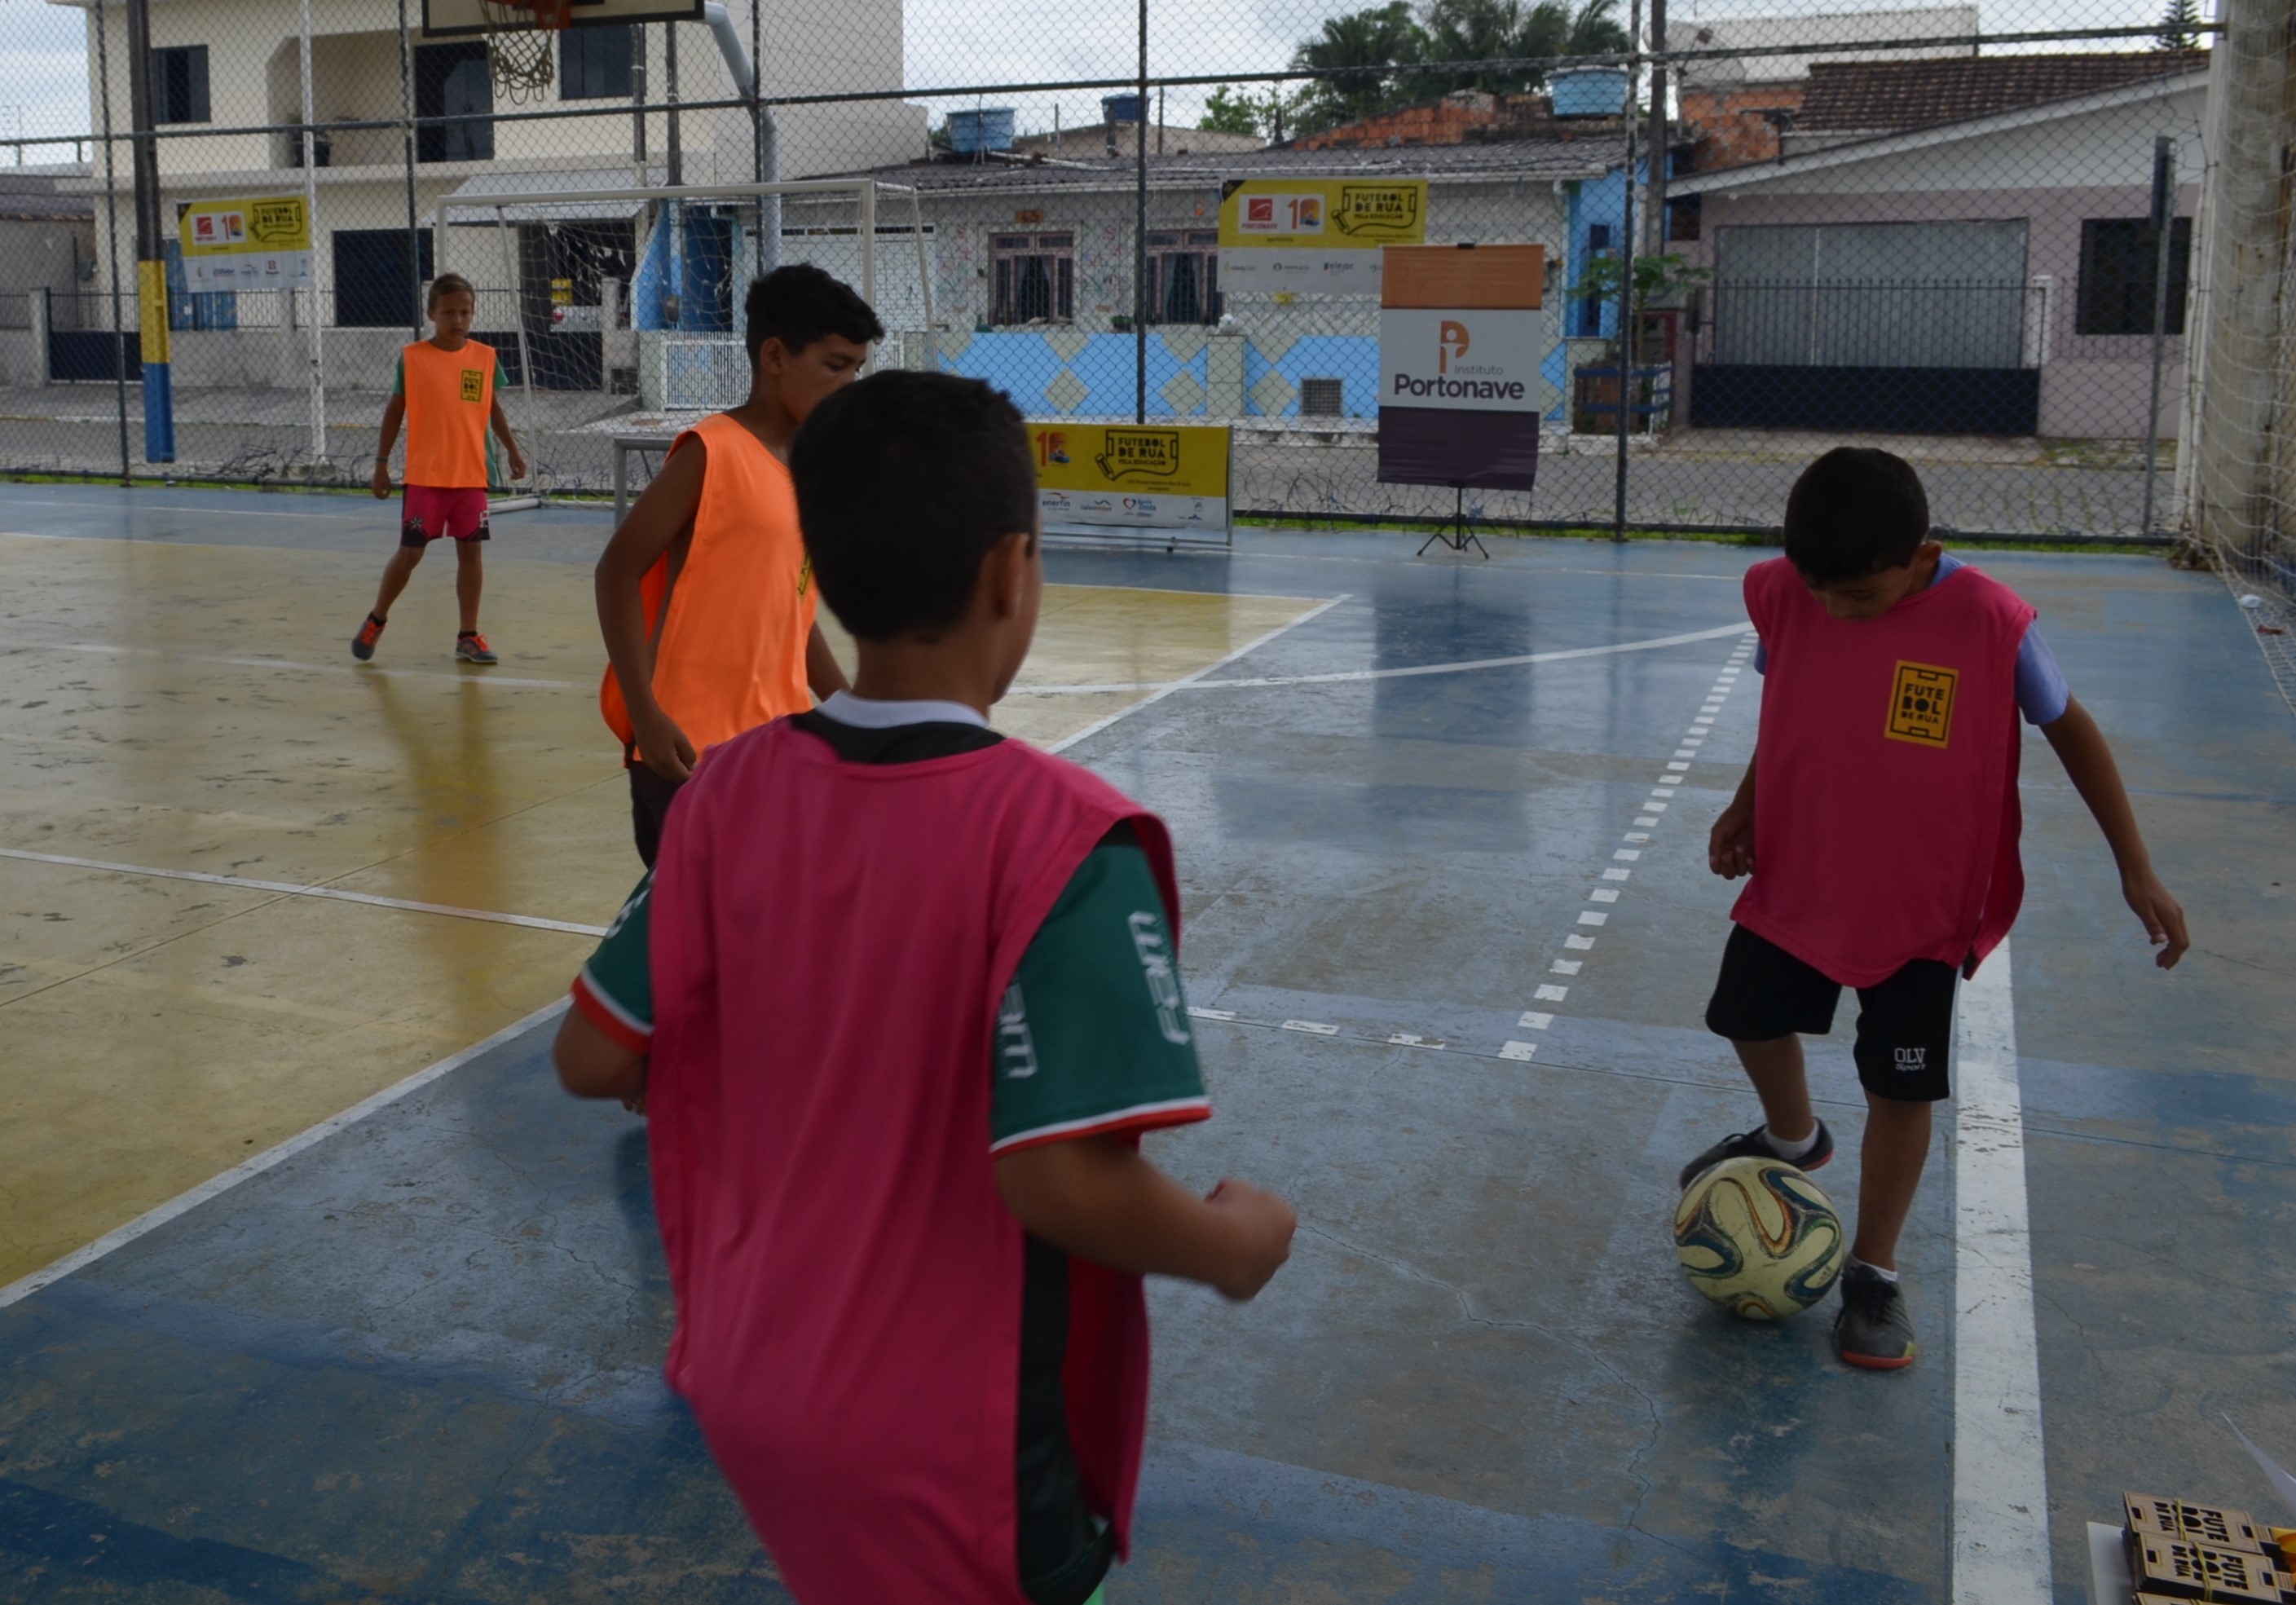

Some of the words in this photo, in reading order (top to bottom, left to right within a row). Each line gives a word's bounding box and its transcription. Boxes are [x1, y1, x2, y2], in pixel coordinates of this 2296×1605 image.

[1355, 193, 1404, 202] FUTEBOL
[1355, 203, 1372, 212] DE
[1377, 203, 1404, 212] RUA
[1455, 364, 1504, 376] Instituto
[1394, 373, 1525, 400] Portonave
[1118, 437, 1166, 448] FUTEBOL
[1118, 448, 1135, 457] DE
[1139, 448, 1166, 458] RUA
[1042, 498, 1071, 508] enerfin
[1904, 683, 1946, 700] FUTE
[1902, 695, 1941, 716] BOL
[1901, 711, 1915, 720] DE
[1917, 713, 1939, 725] RUA
[1894, 1047, 1926, 1064] OLV
[2157, 1514, 2175, 1532] RUA
[2199, 1509, 2231, 1543] FUTE
[2170, 1545, 2188, 1558] DE
[2174, 1558, 2191, 1577] RUA
[2219, 1553, 2250, 1590] FUTE
